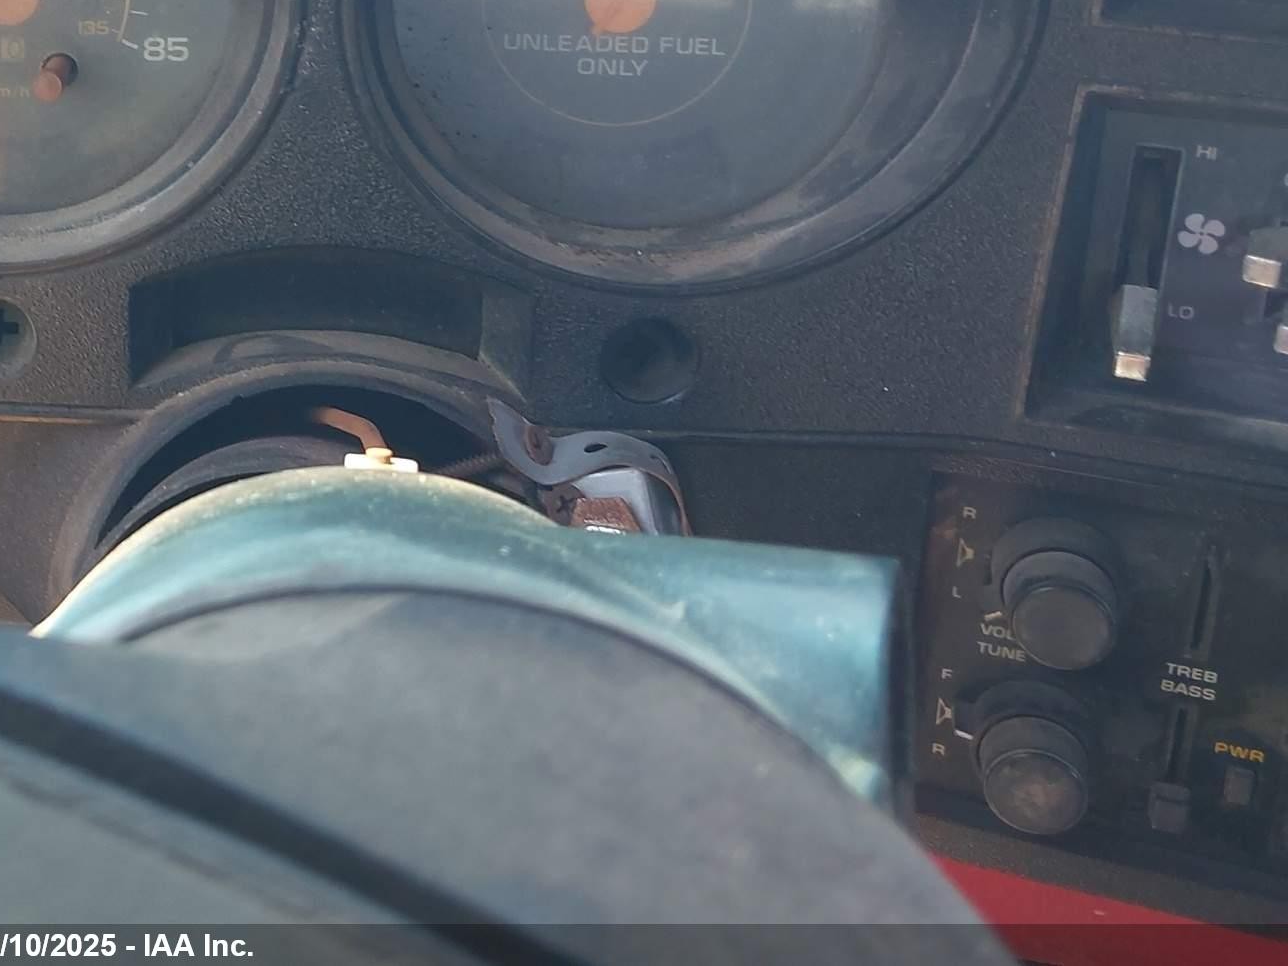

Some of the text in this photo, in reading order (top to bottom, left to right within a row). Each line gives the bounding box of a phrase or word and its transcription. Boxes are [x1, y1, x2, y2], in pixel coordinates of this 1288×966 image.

[78, 19, 109, 35] 135
[143, 37, 188, 62] 85
[503, 34, 726, 55] UNLEADED FUEL
[576, 58, 648, 77] ONLY
[1196, 145, 1217, 161] HI
[1168, 303, 1195, 321] LO
[962, 507, 977, 520] R
[952, 586, 961, 599] L
[980, 623, 1016, 641] VOL
[976, 641, 1026, 662] TUNE
[941, 669, 953, 680] F
[1166, 662, 1218, 684] TREB
[1160, 680, 1216, 701] BASS
[931, 743, 945, 756] R
[1214, 742, 1265, 763] PWR
